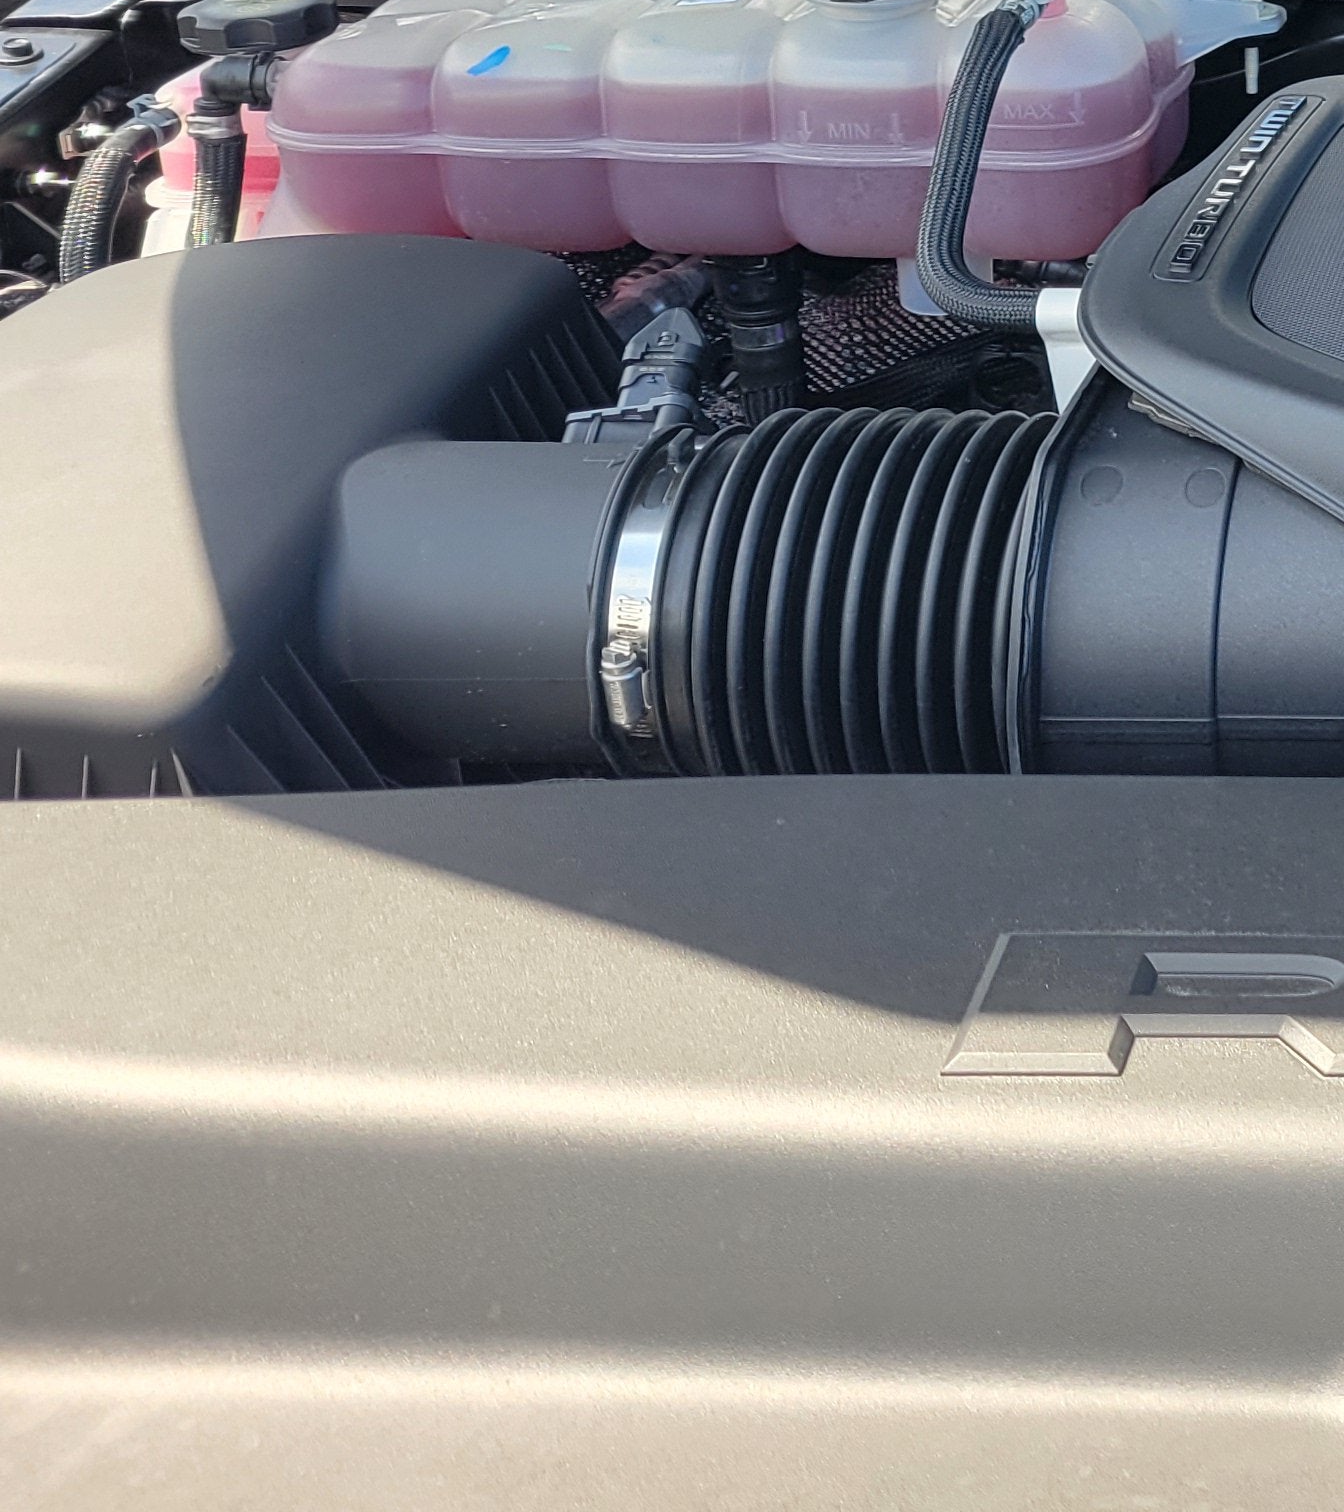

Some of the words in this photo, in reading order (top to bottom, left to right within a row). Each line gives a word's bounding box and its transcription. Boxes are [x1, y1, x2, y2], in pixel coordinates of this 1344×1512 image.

[826, 122, 872, 139] MIN
[1003, 102, 1056, 121] MAX
[1240, 95, 1308, 160] TWIN
[1169, 159, 1257, 273] TURBO
